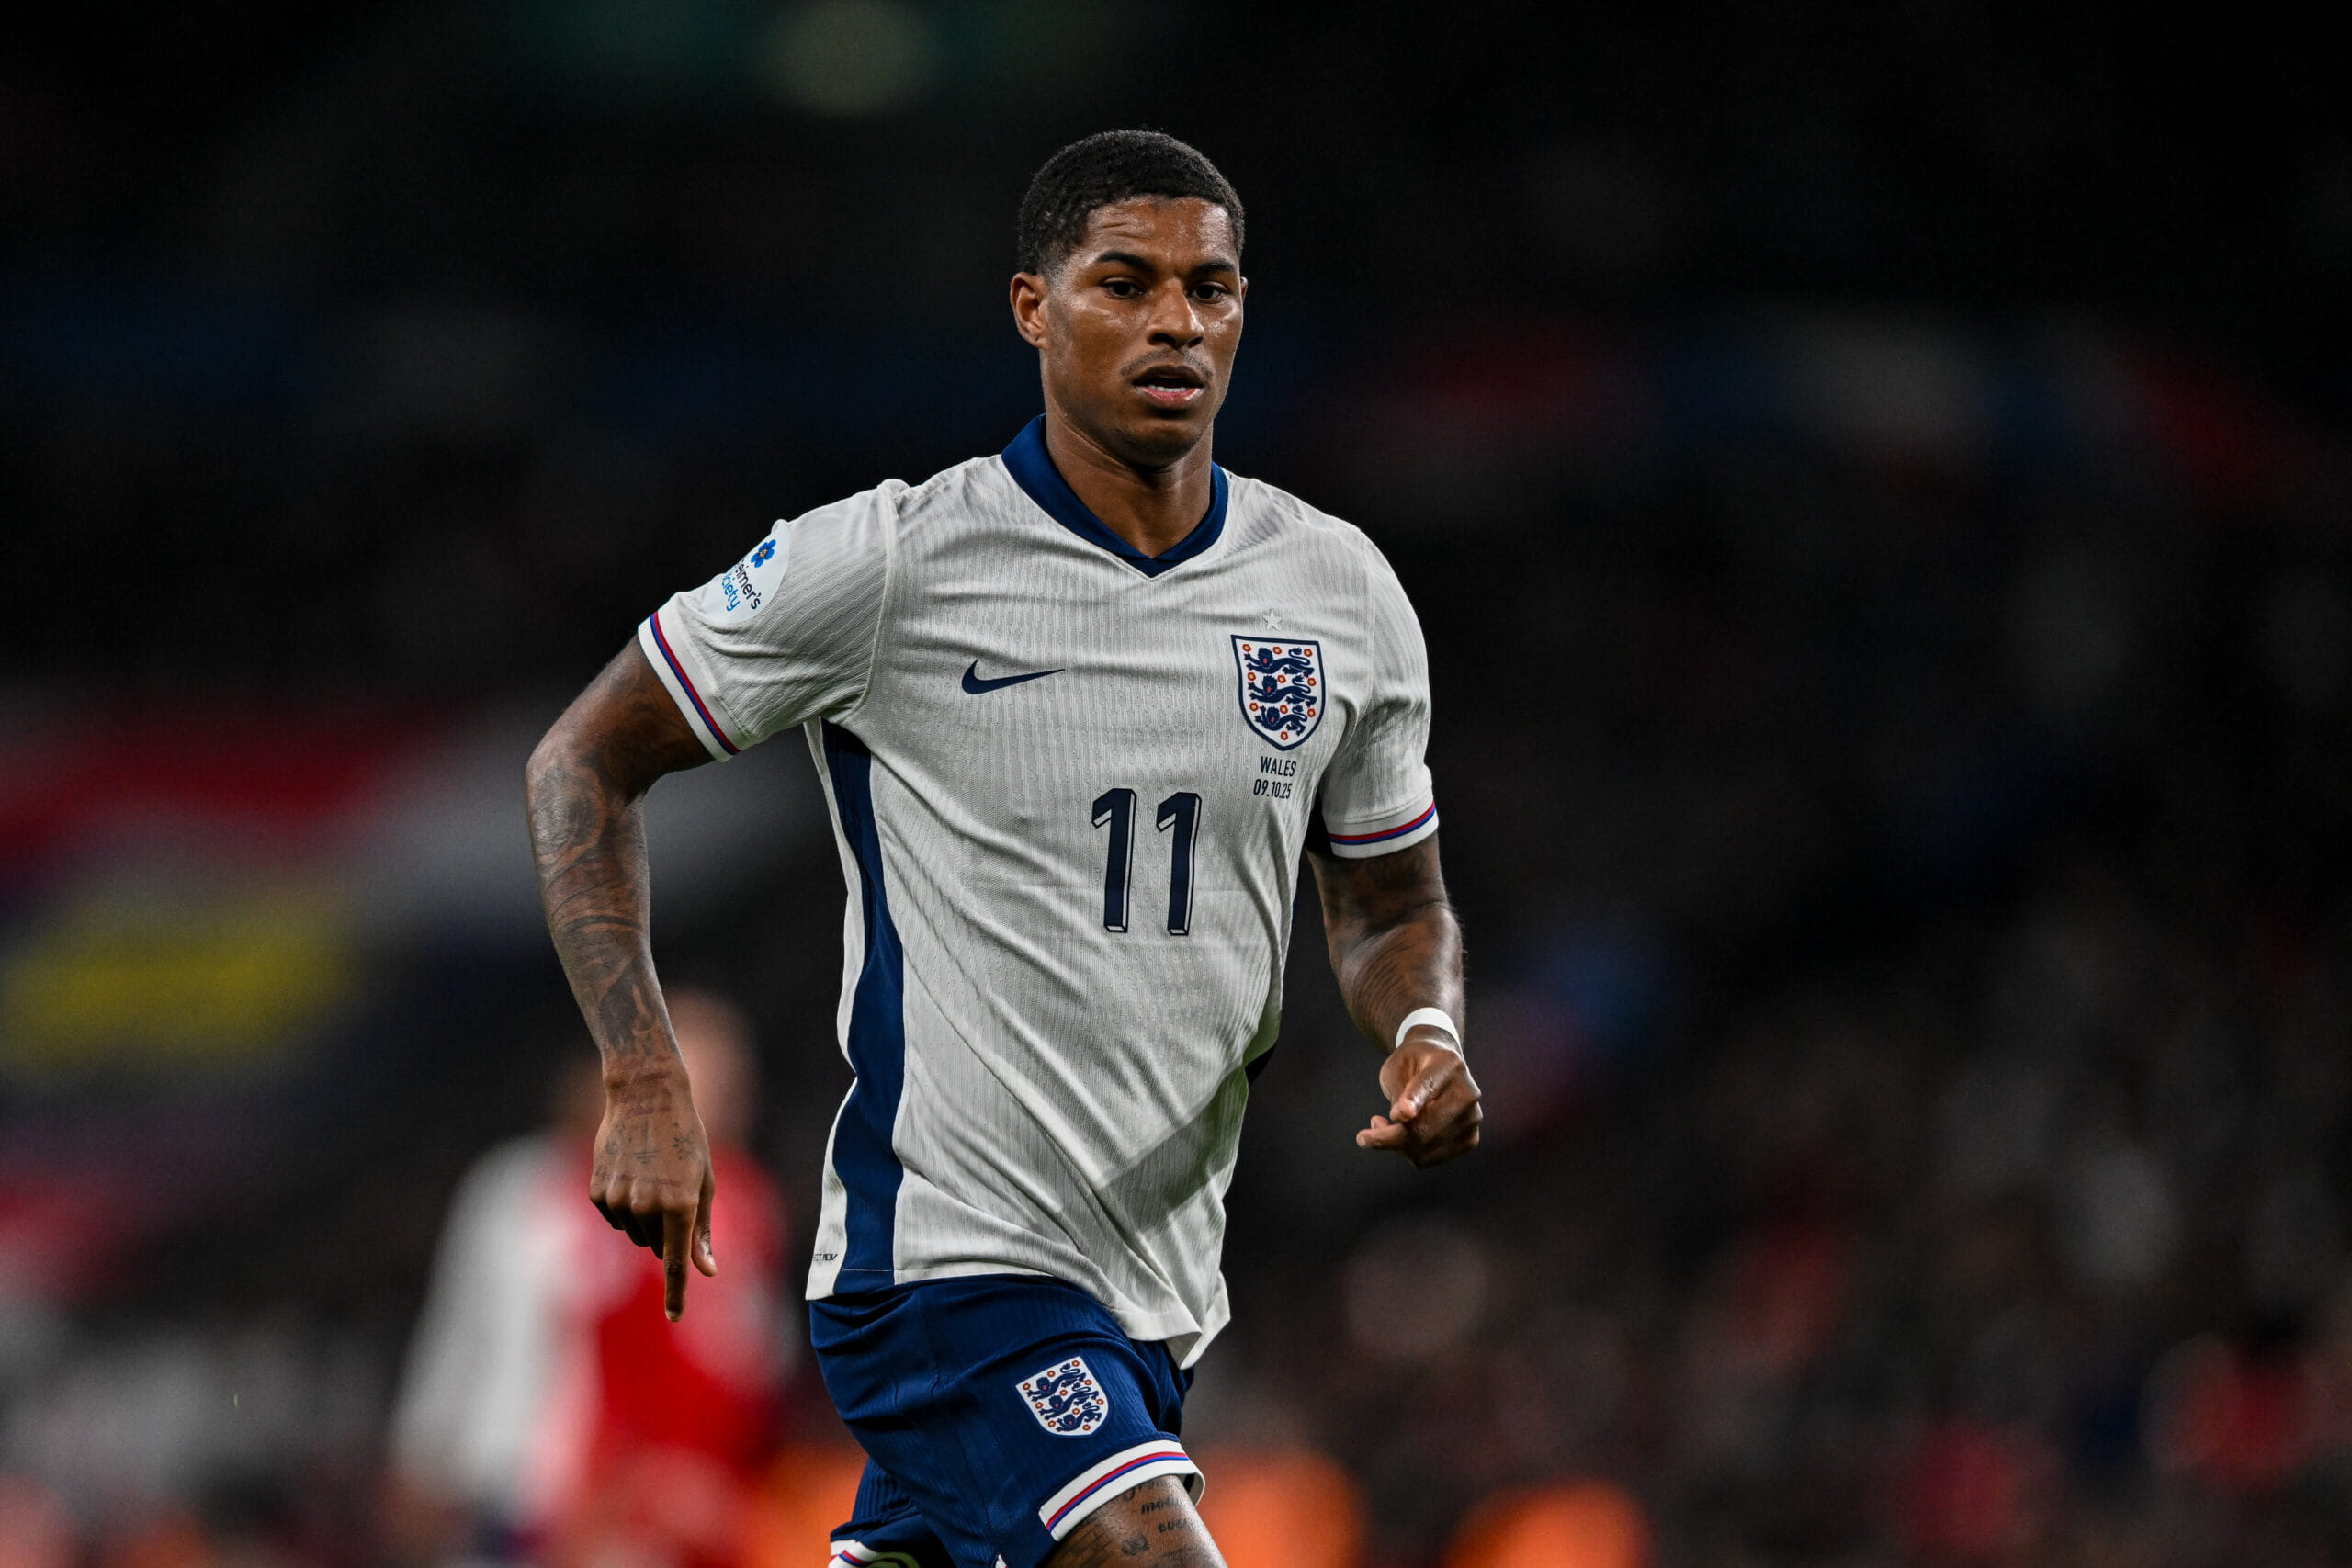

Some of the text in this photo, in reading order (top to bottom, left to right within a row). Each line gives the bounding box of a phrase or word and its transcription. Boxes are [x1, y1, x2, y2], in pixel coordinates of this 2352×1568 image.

[721, 572, 741, 612] ciety
[1261, 756, 1297, 777] WALES
[1252, 778, 1294, 799] 09.10.25
[1091, 787, 1203, 936] 11
